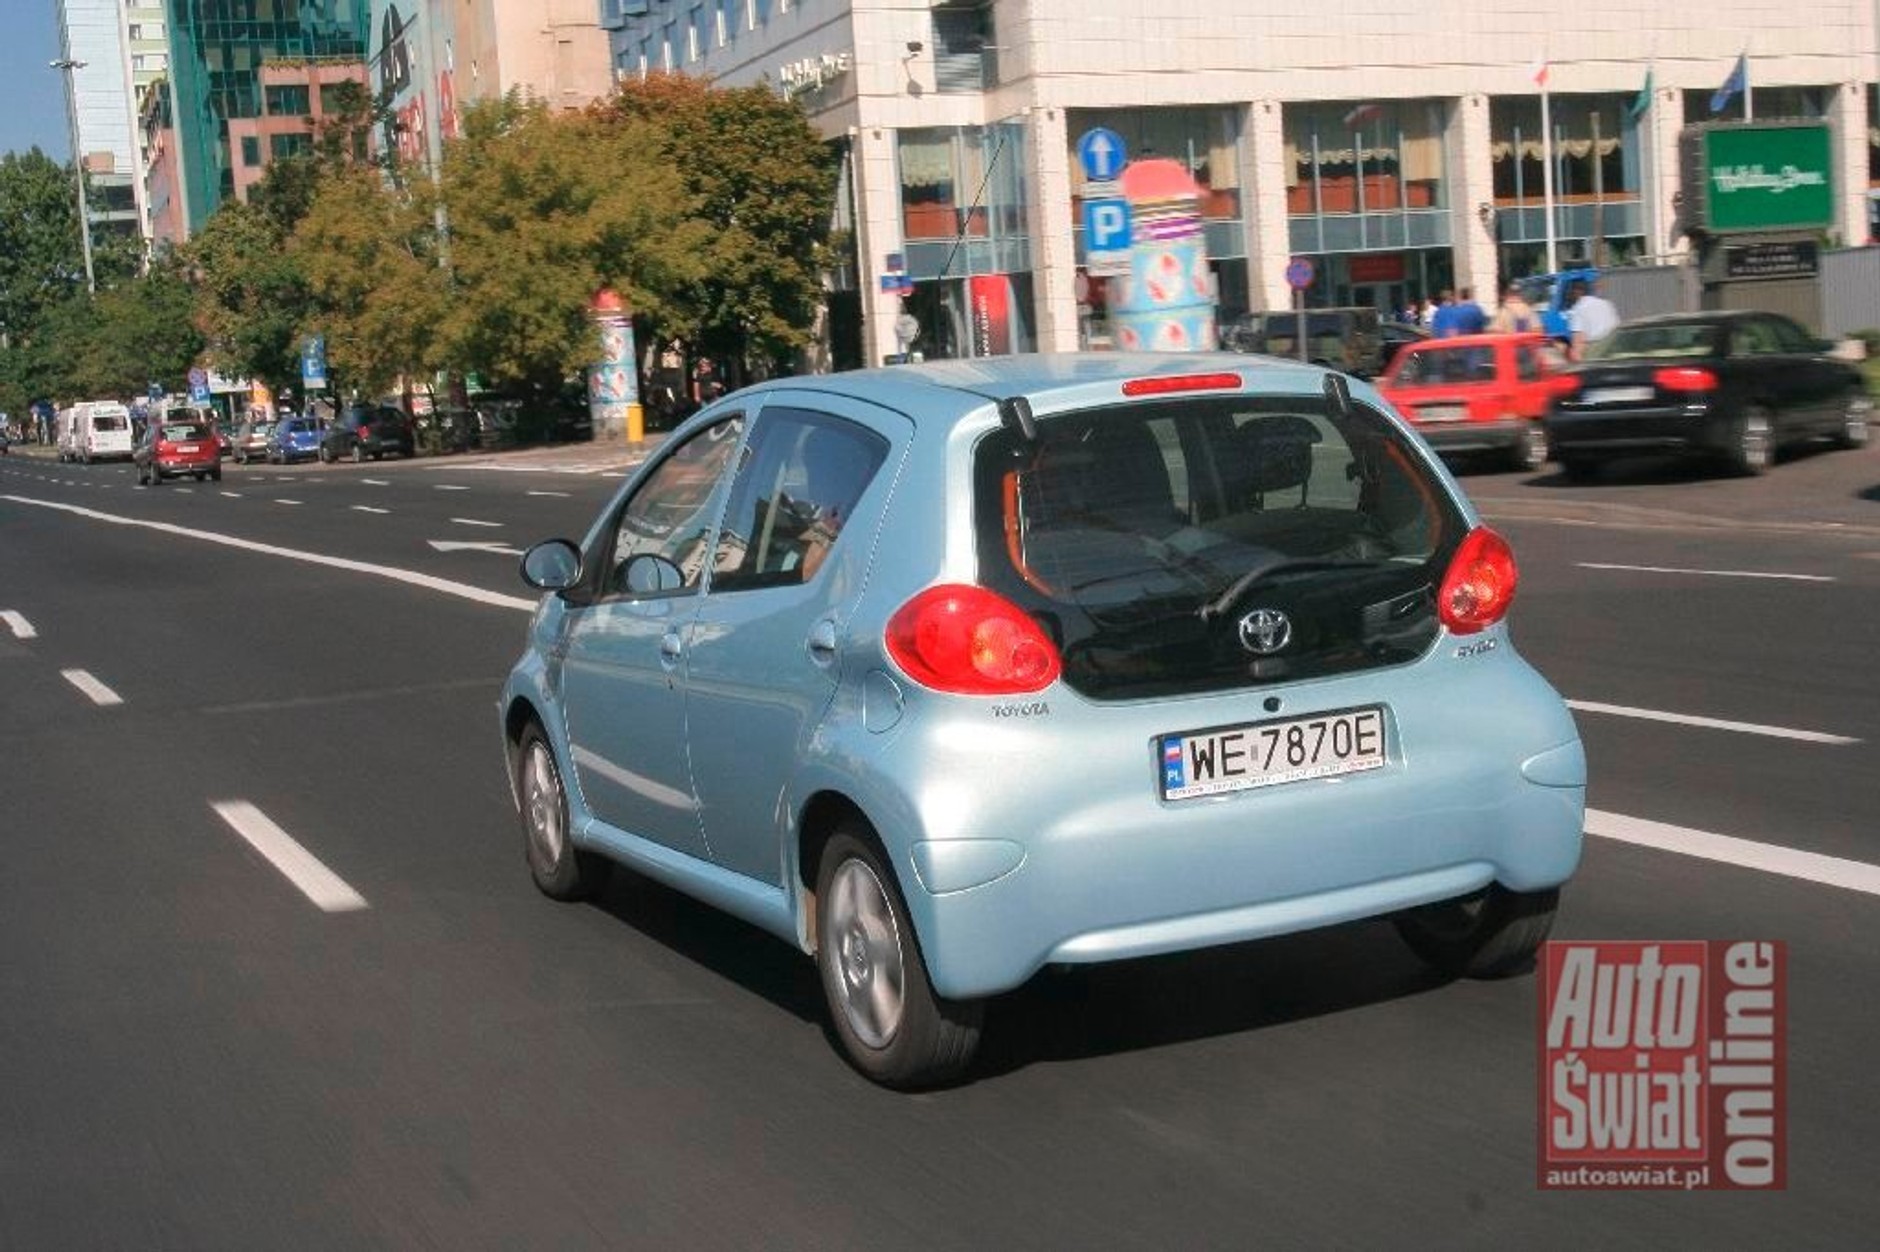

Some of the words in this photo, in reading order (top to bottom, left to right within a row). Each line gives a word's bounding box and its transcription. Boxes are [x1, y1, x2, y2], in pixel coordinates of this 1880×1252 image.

[1092, 206, 1124, 245] P
[991, 703, 1050, 717] TOYOTA
[1190, 733, 1246, 781] WE
[1261, 714, 1377, 771] 7870E
[1167, 769, 1181, 781] PL
